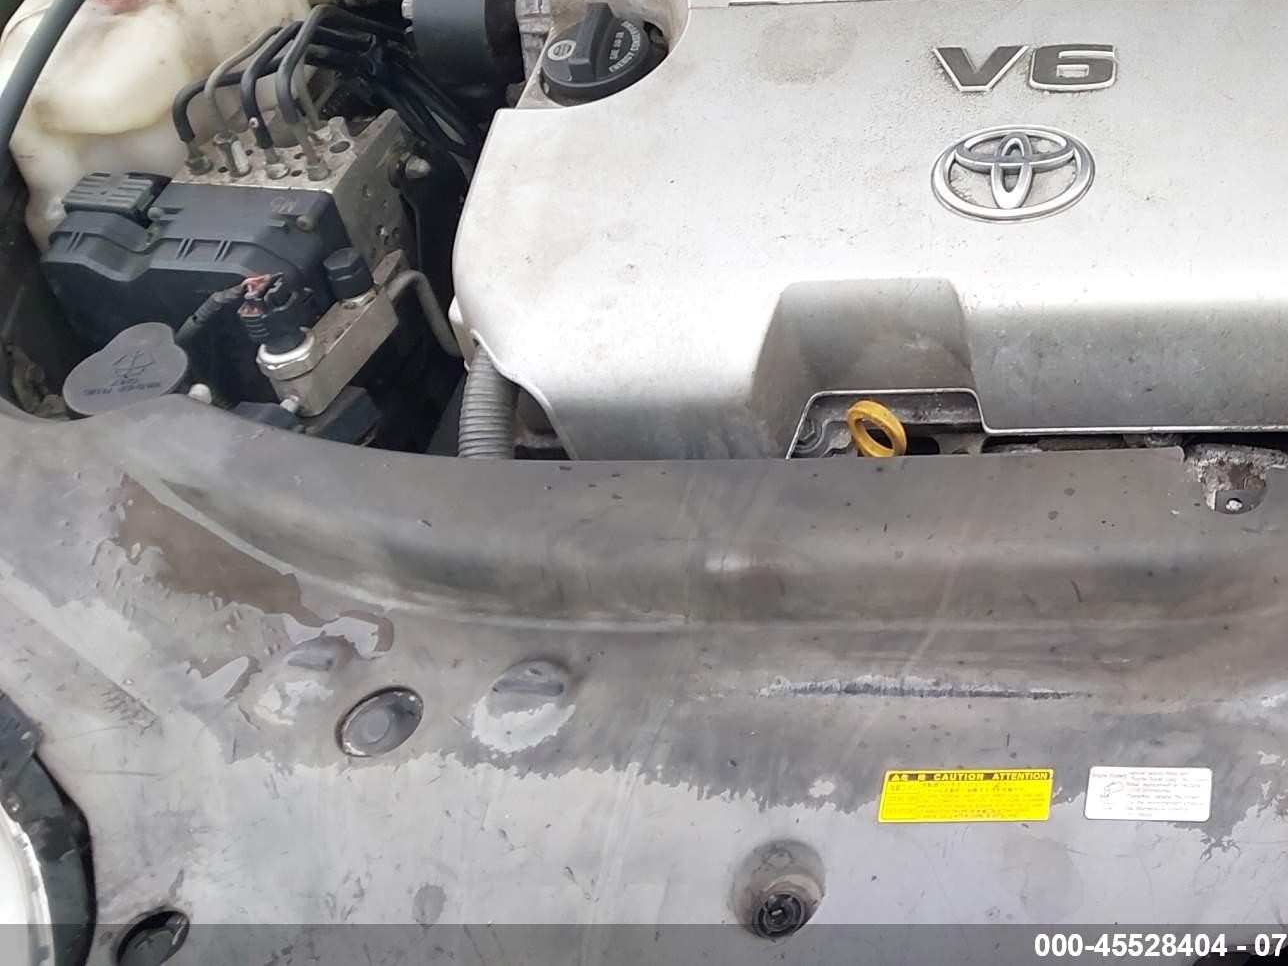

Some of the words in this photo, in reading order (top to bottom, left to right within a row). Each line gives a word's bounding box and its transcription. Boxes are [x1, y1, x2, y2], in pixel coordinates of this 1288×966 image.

[932, 43, 1118, 94] V6
[933, 773, 984, 781] CAUTION
[991, 772, 1048, 780] ATTENTION
